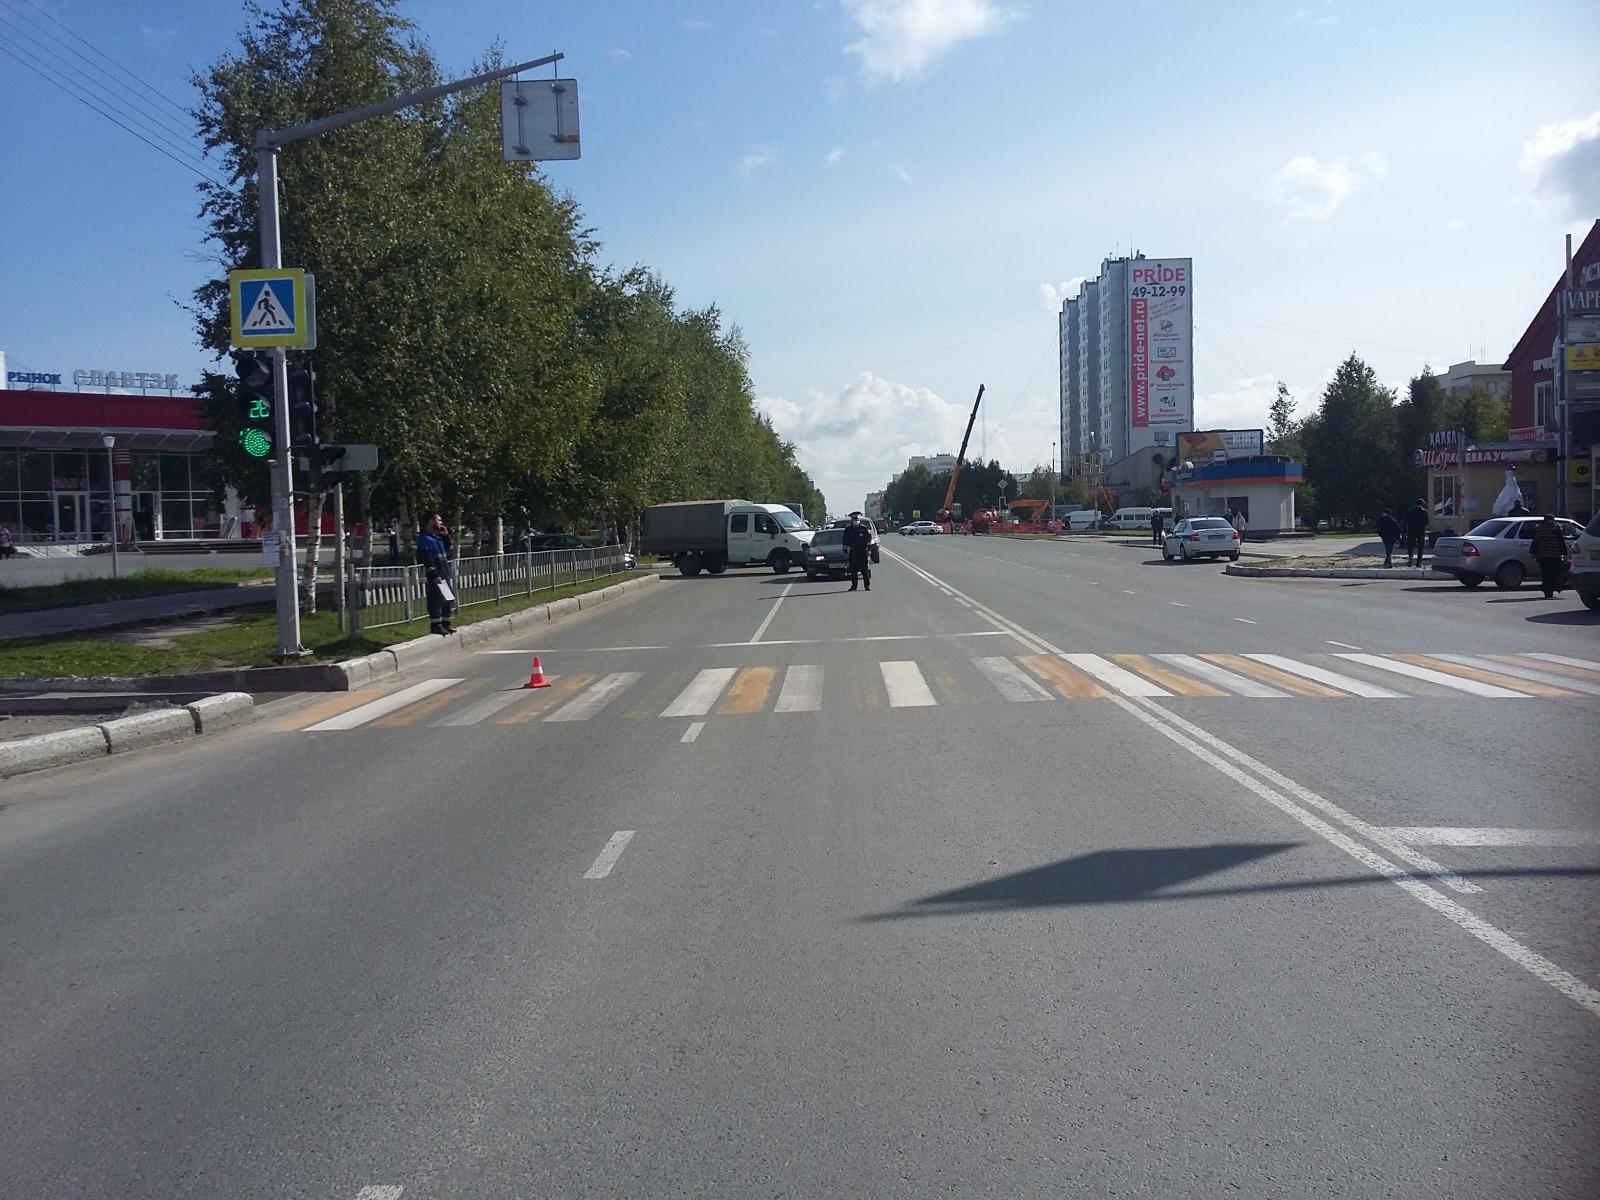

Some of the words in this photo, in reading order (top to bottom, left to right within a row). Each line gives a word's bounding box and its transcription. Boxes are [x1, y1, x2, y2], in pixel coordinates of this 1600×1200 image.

[1132, 264, 1186, 283] PRIDE
[1132, 286, 1186, 297] 49-12-99
[7, 371, 61, 384] РЫНОК
[73, 368, 178, 390] СЛАВТЭК
